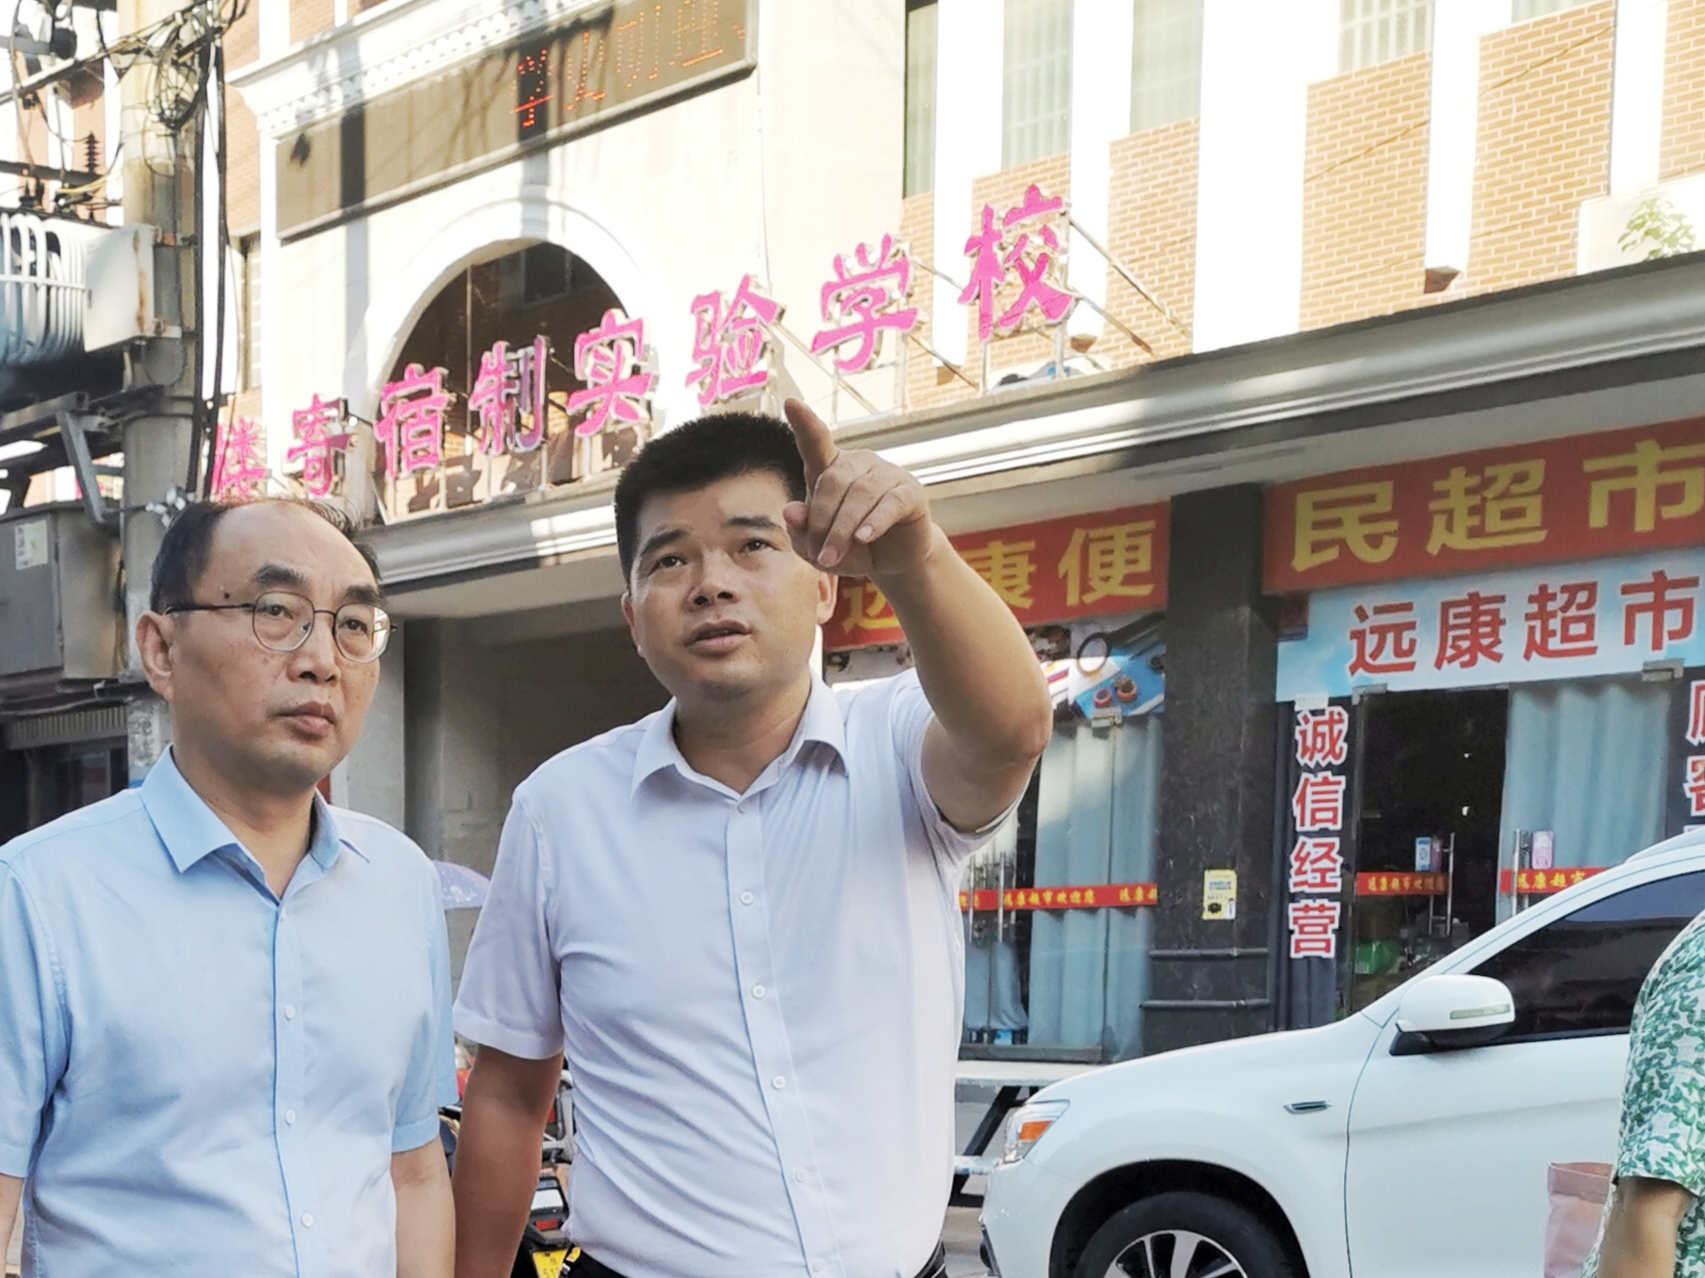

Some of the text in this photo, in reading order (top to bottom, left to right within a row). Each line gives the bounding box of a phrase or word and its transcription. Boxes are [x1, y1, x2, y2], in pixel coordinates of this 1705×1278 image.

[1289, 438, 1705, 573] 民超市
[1347, 569, 1699, 679] 远康超市
[1288, 704, 1349, 960] 诚信经营
